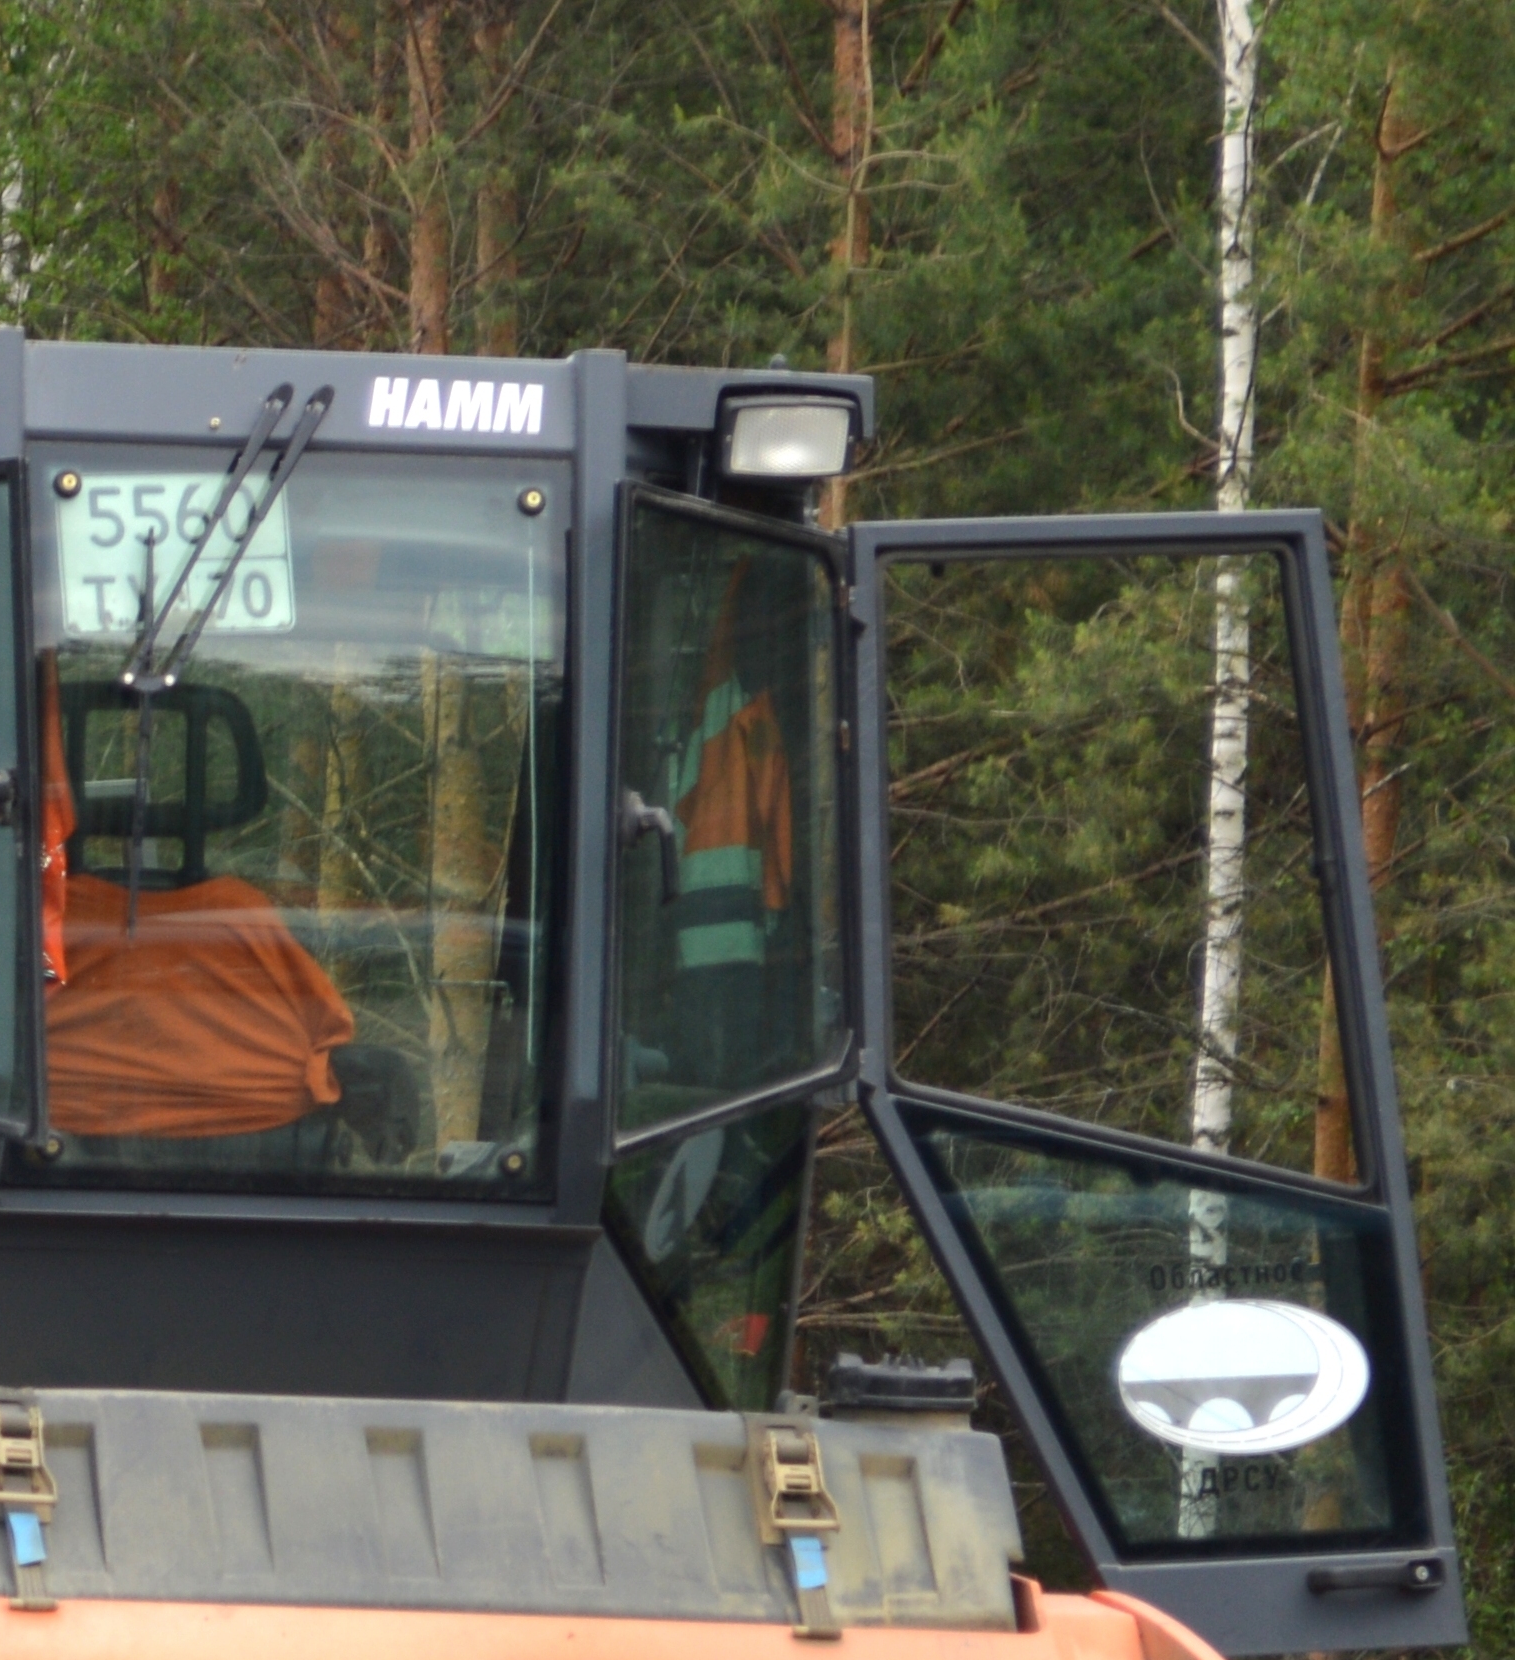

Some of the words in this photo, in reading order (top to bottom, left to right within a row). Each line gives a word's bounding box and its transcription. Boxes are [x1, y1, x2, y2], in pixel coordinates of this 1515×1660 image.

[368, 376, 545, 436] HAMM
[88, 483, 258, 548] 5560
[1198, 1464, 1280, 1499] ДРСУ
